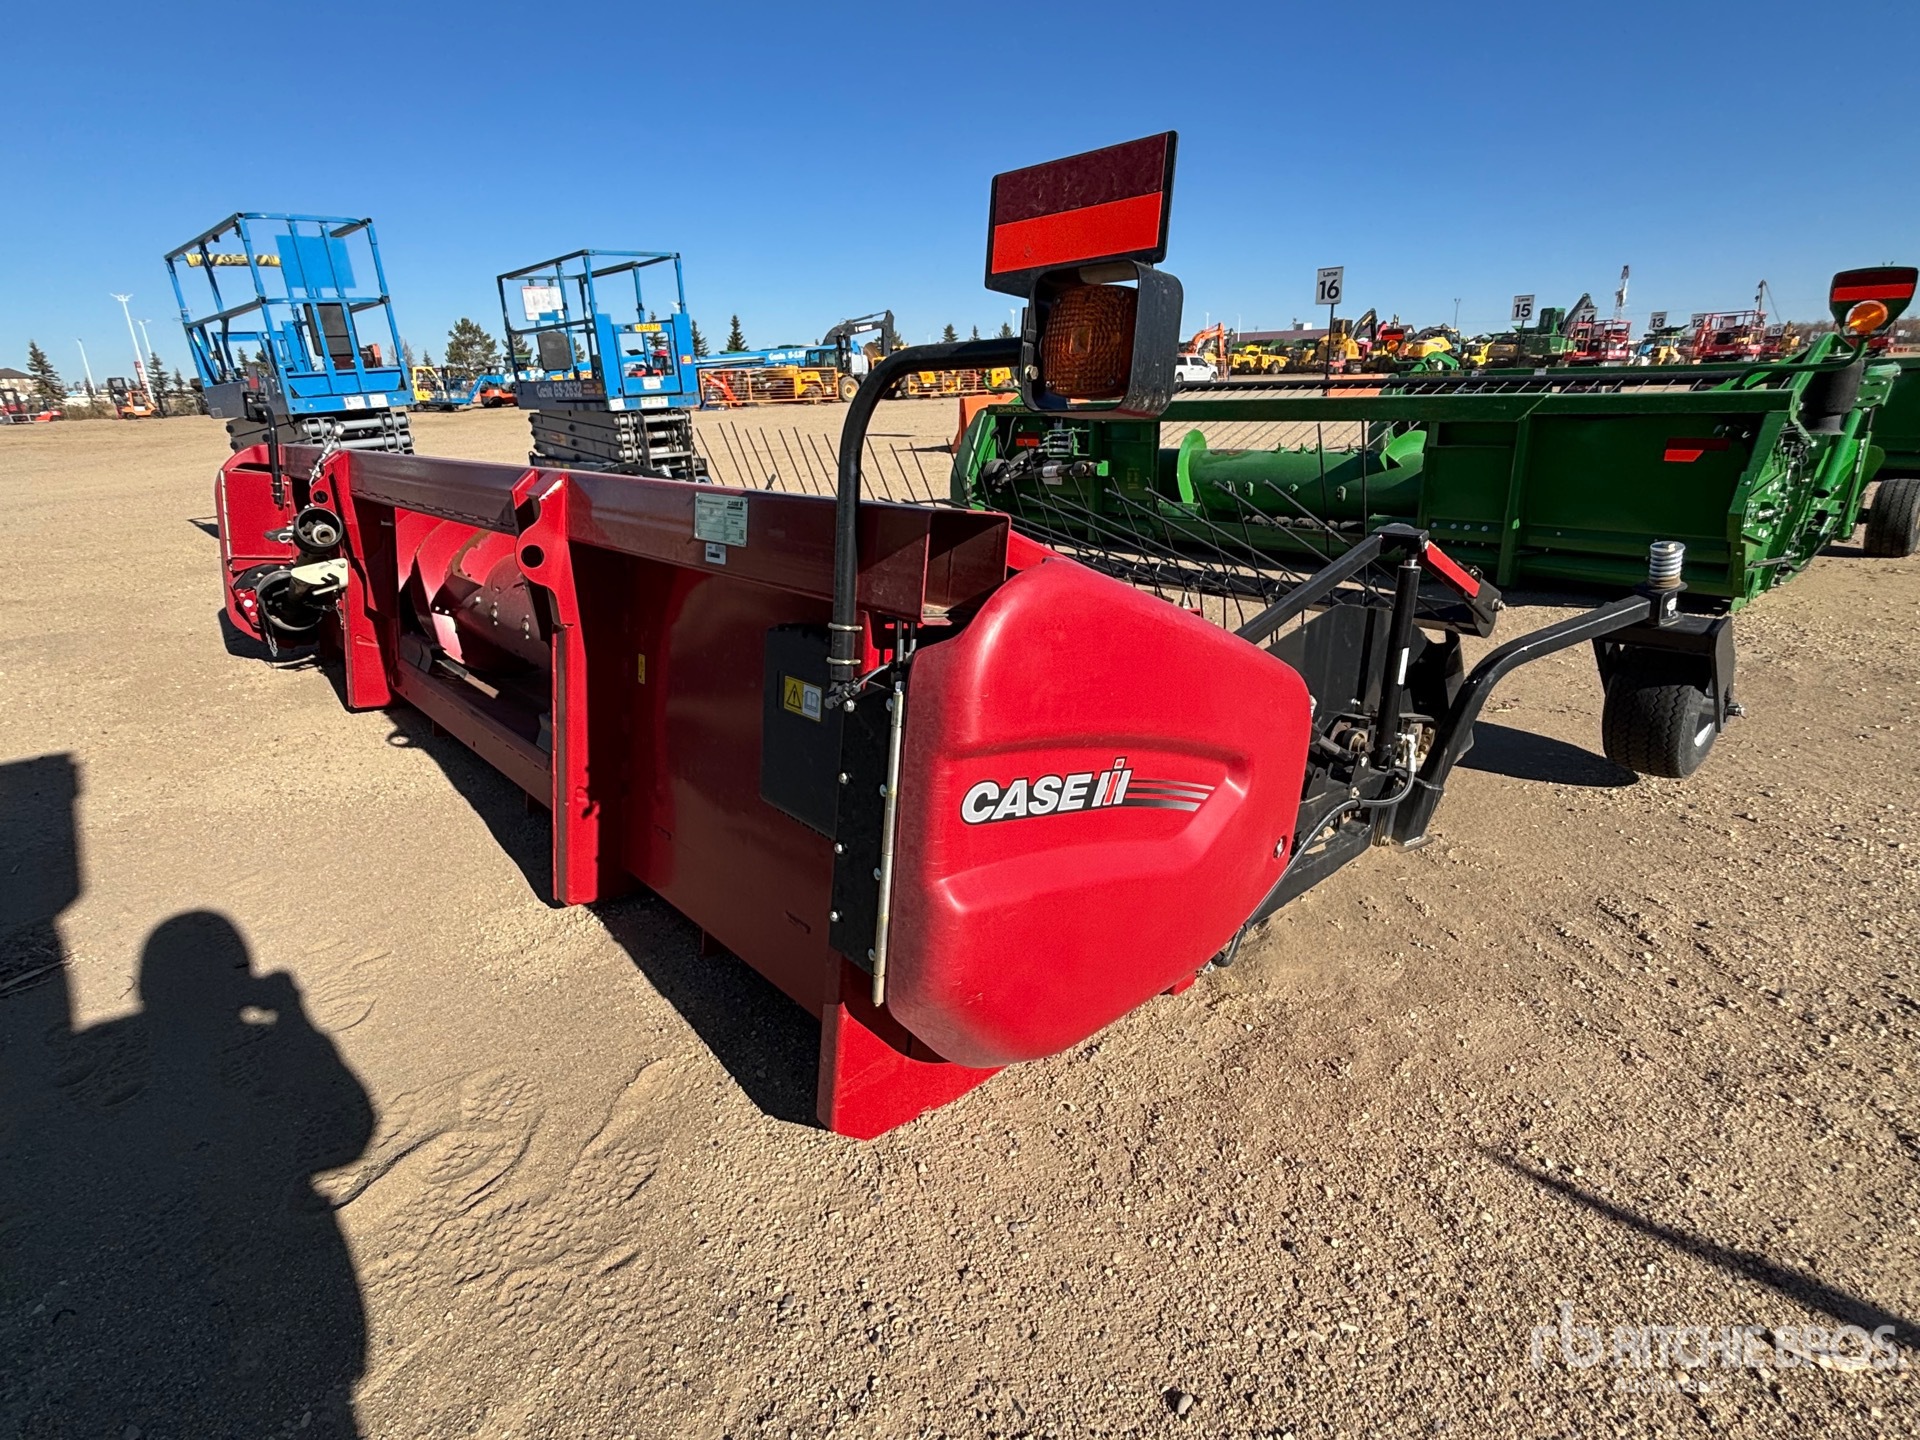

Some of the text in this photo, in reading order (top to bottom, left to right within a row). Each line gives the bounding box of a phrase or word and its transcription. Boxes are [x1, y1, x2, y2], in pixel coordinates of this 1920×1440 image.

[1319, 279, 1340, 300] 16
[1514, 303, 1531, 318] 15
[1652, 317, 1664, 328] 13
[1692, 318, 1704, 328] 12
[536, 384, 553, 398] Genie
[961, 773, 1093, 824] CASE
